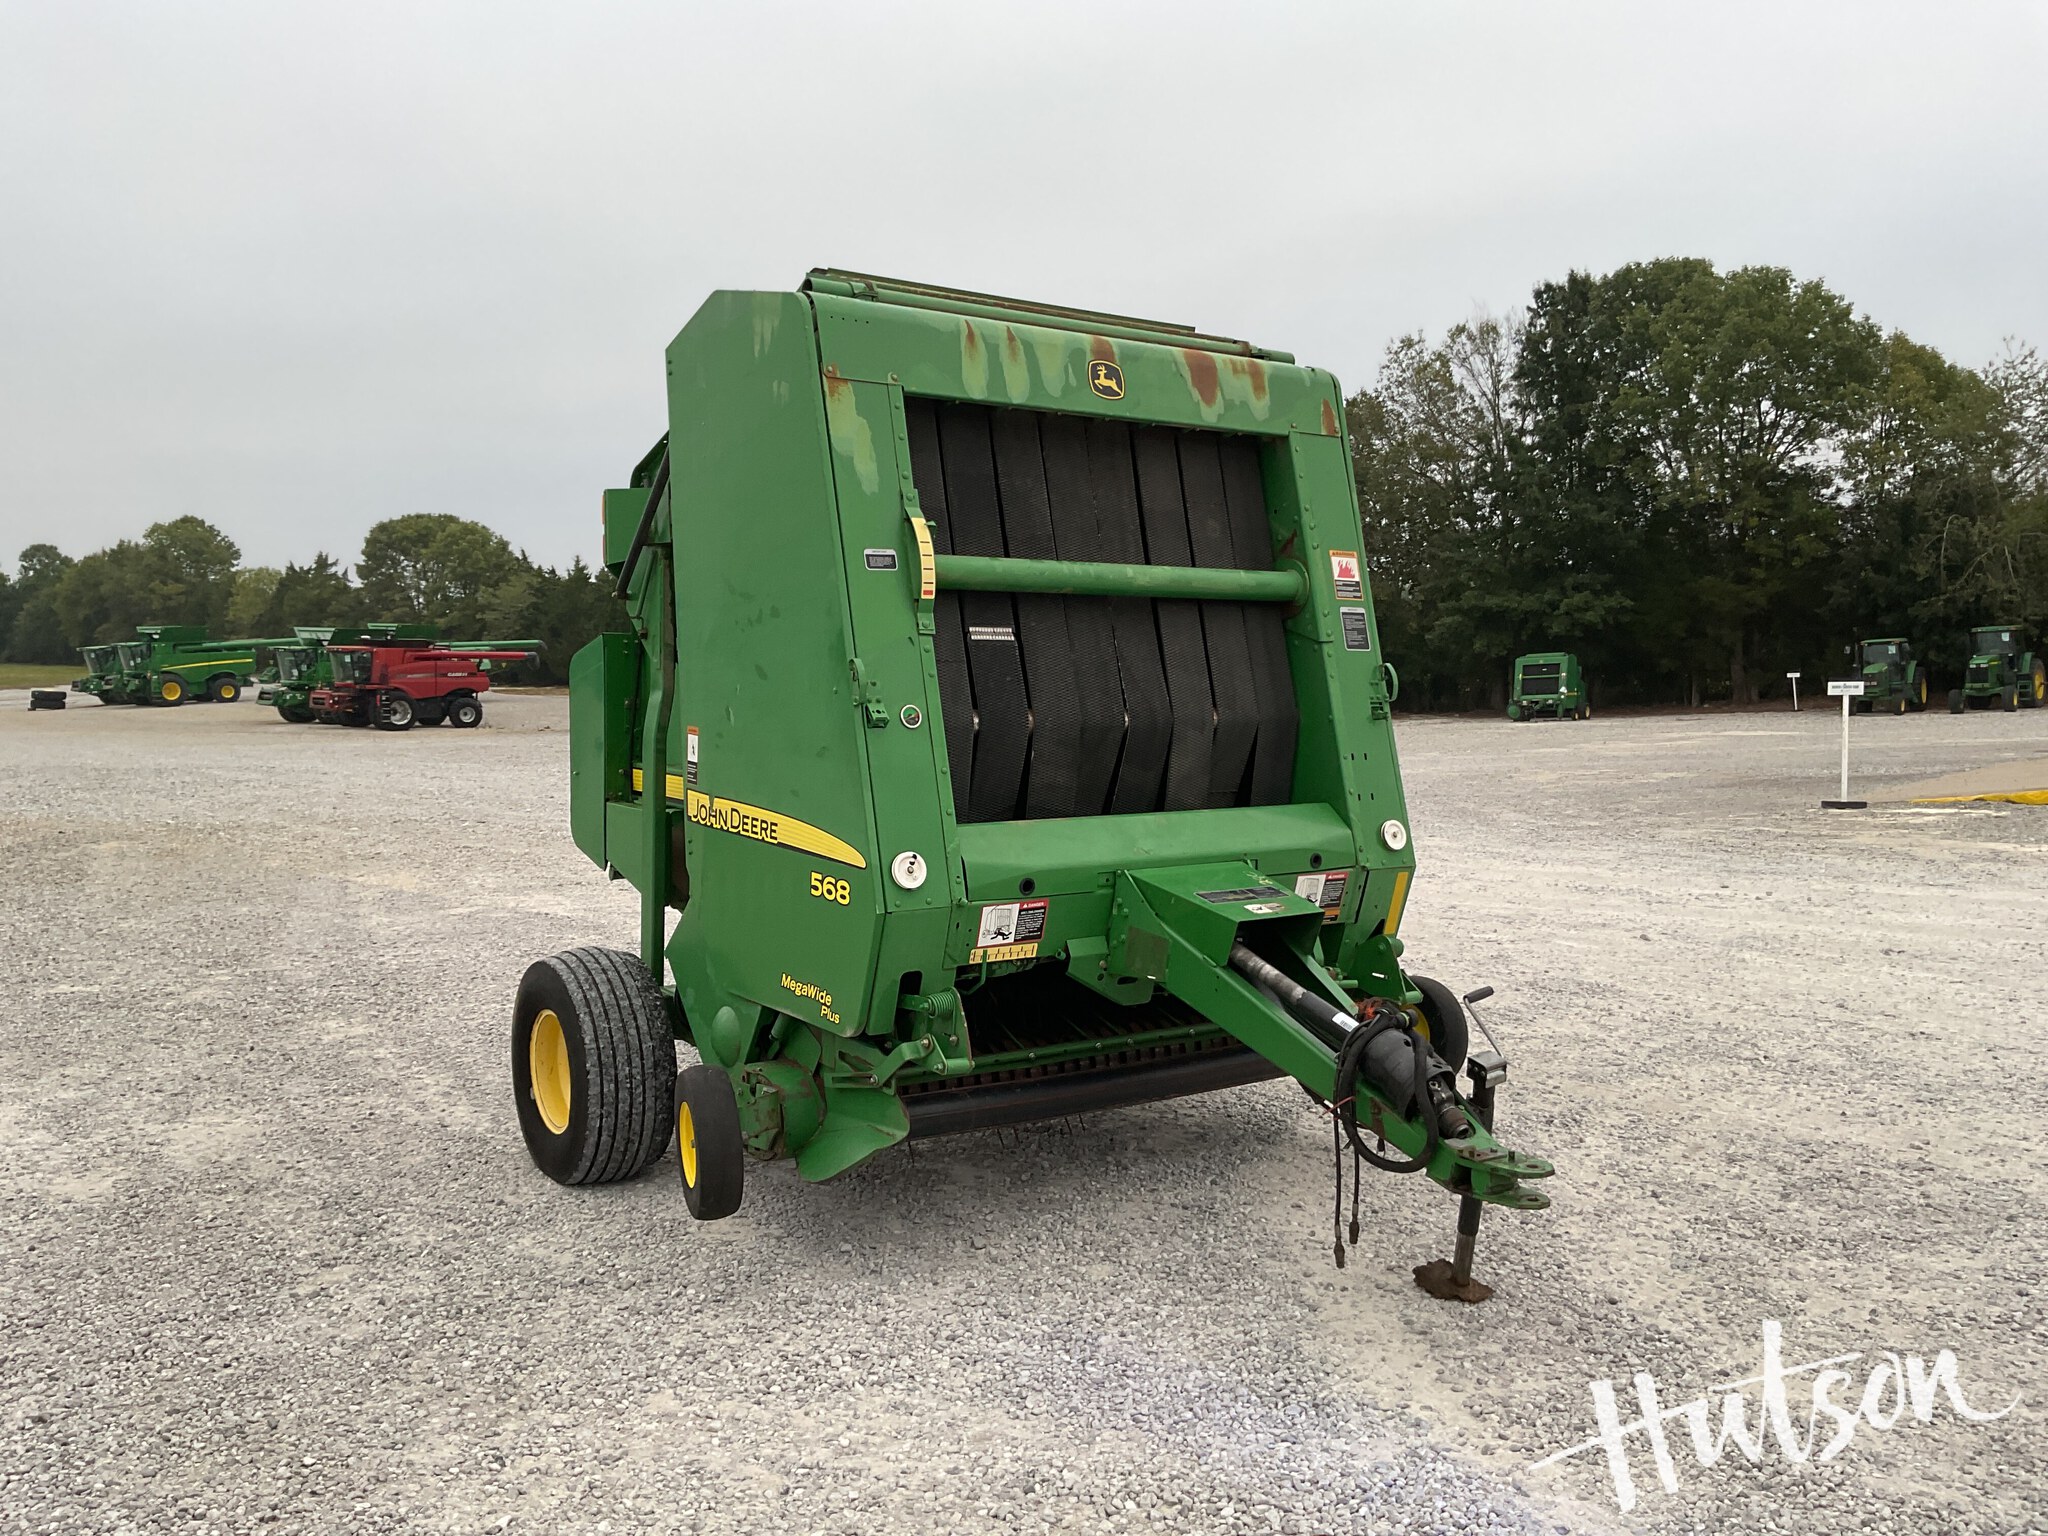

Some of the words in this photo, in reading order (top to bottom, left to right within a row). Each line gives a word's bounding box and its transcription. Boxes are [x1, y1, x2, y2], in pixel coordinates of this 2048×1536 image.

[692, 799, 728, 827] JOHN
[730, 807, 778, 841] DEERE
[810, 872, 851, 906] 568
[781, 973, 832, 1006] MegaWide
[819, 1004, 840, 1024] Plus
